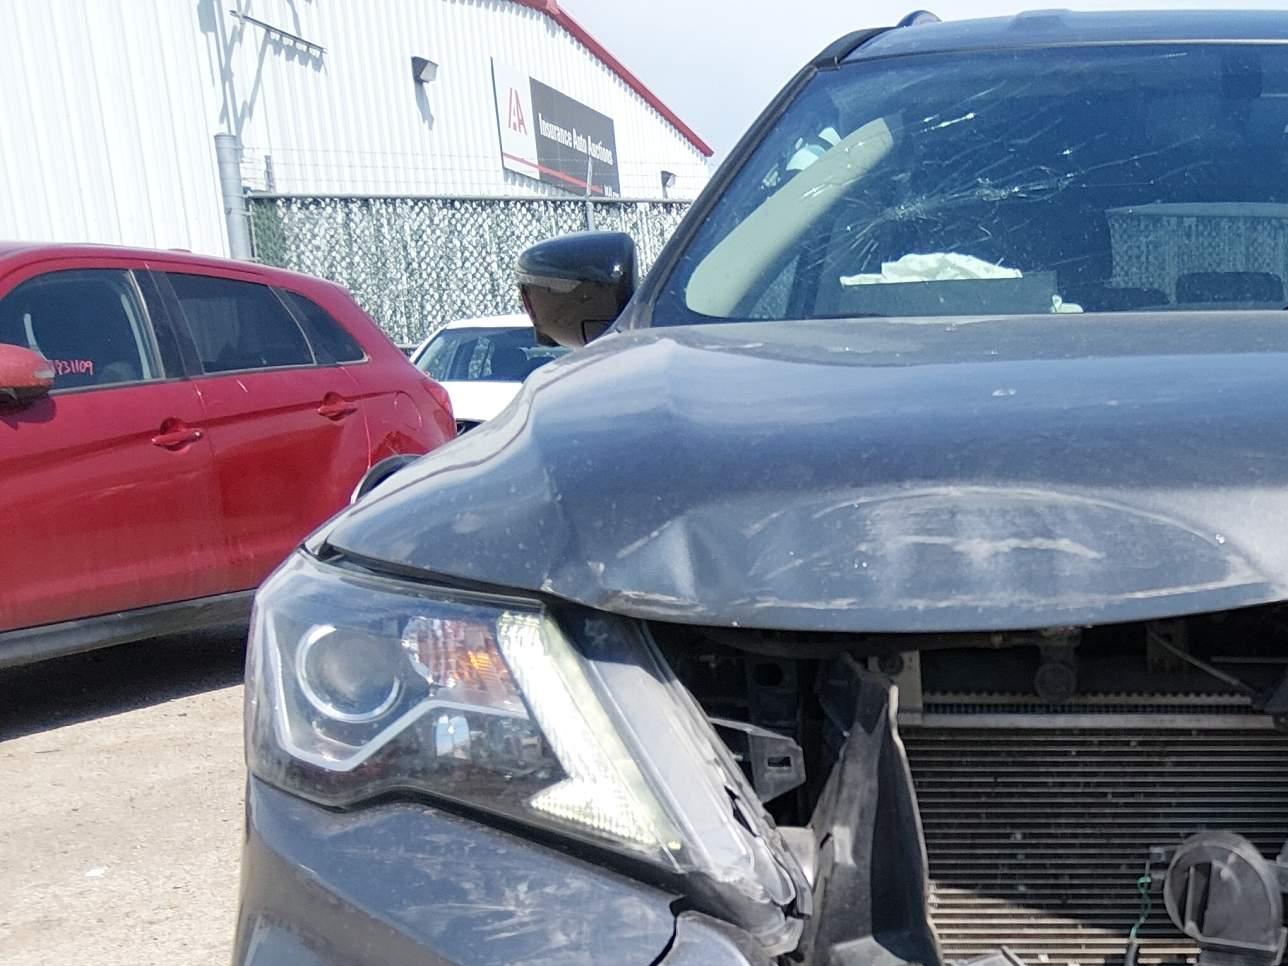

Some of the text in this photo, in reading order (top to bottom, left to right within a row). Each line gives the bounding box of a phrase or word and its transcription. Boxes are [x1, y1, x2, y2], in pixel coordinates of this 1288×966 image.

[538, 112, 614, 166] Insurance Auto Auctions
